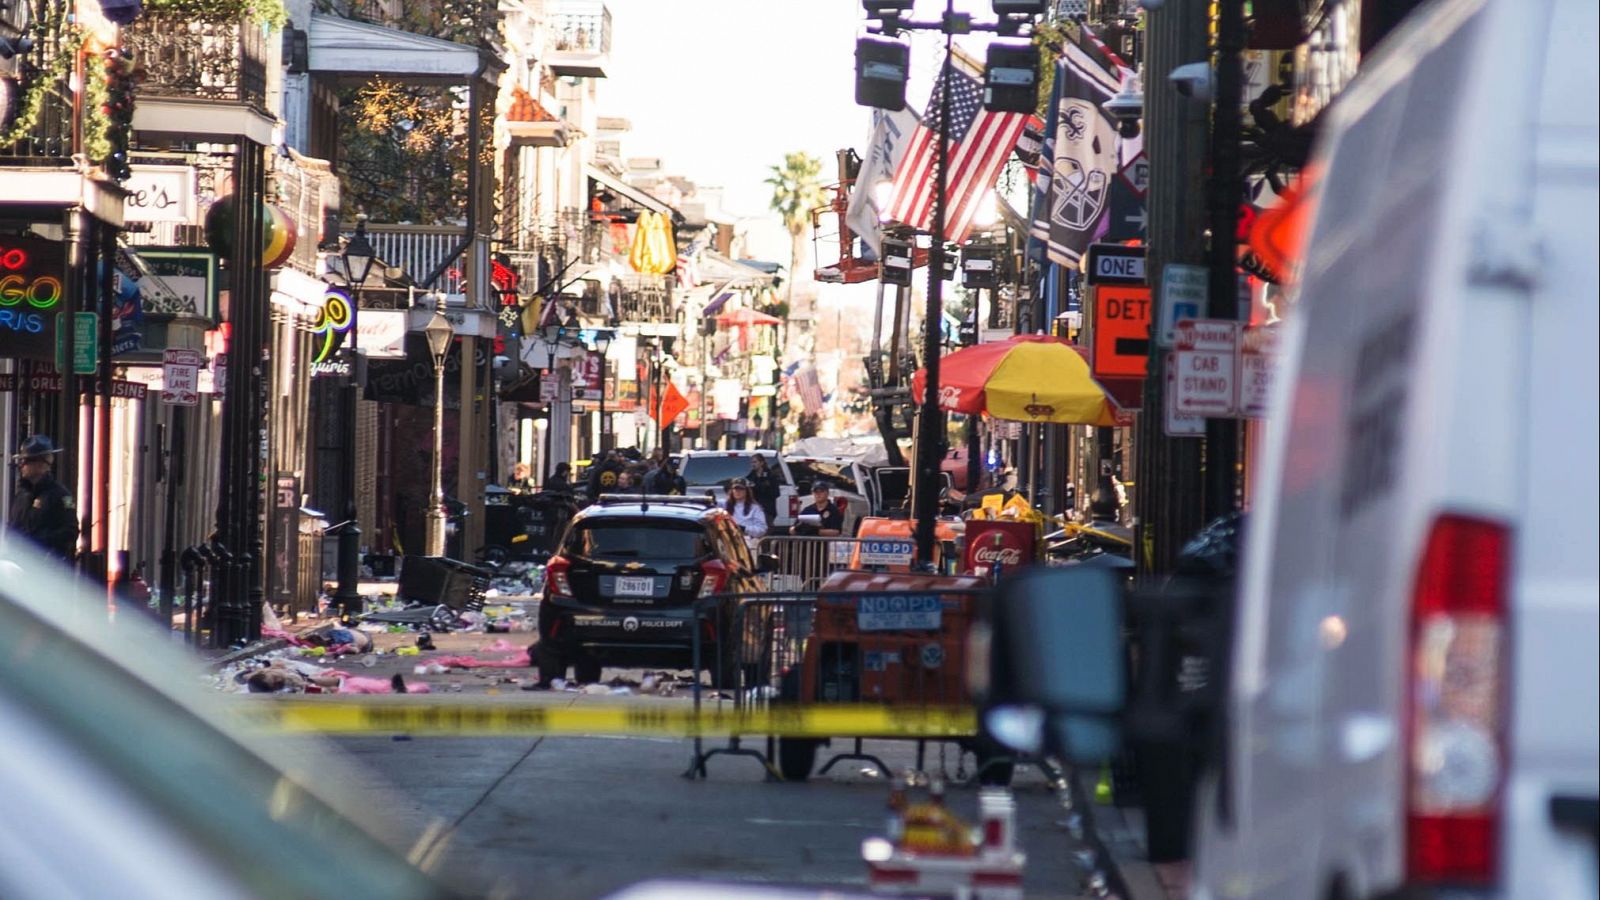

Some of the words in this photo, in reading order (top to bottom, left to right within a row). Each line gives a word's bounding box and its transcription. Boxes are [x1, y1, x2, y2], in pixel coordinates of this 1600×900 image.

[1101, 258, 1136, 275] ONE
[0, 275, 61, 308] GO
[1106, 299, 1149, 319] DET
[1193, 356, 1219, 371] CAB
[171, 367, 191, 378] FIRE
[169, 380, 191, 390] LANE
[1184, 376, 1227, 393] STAND
